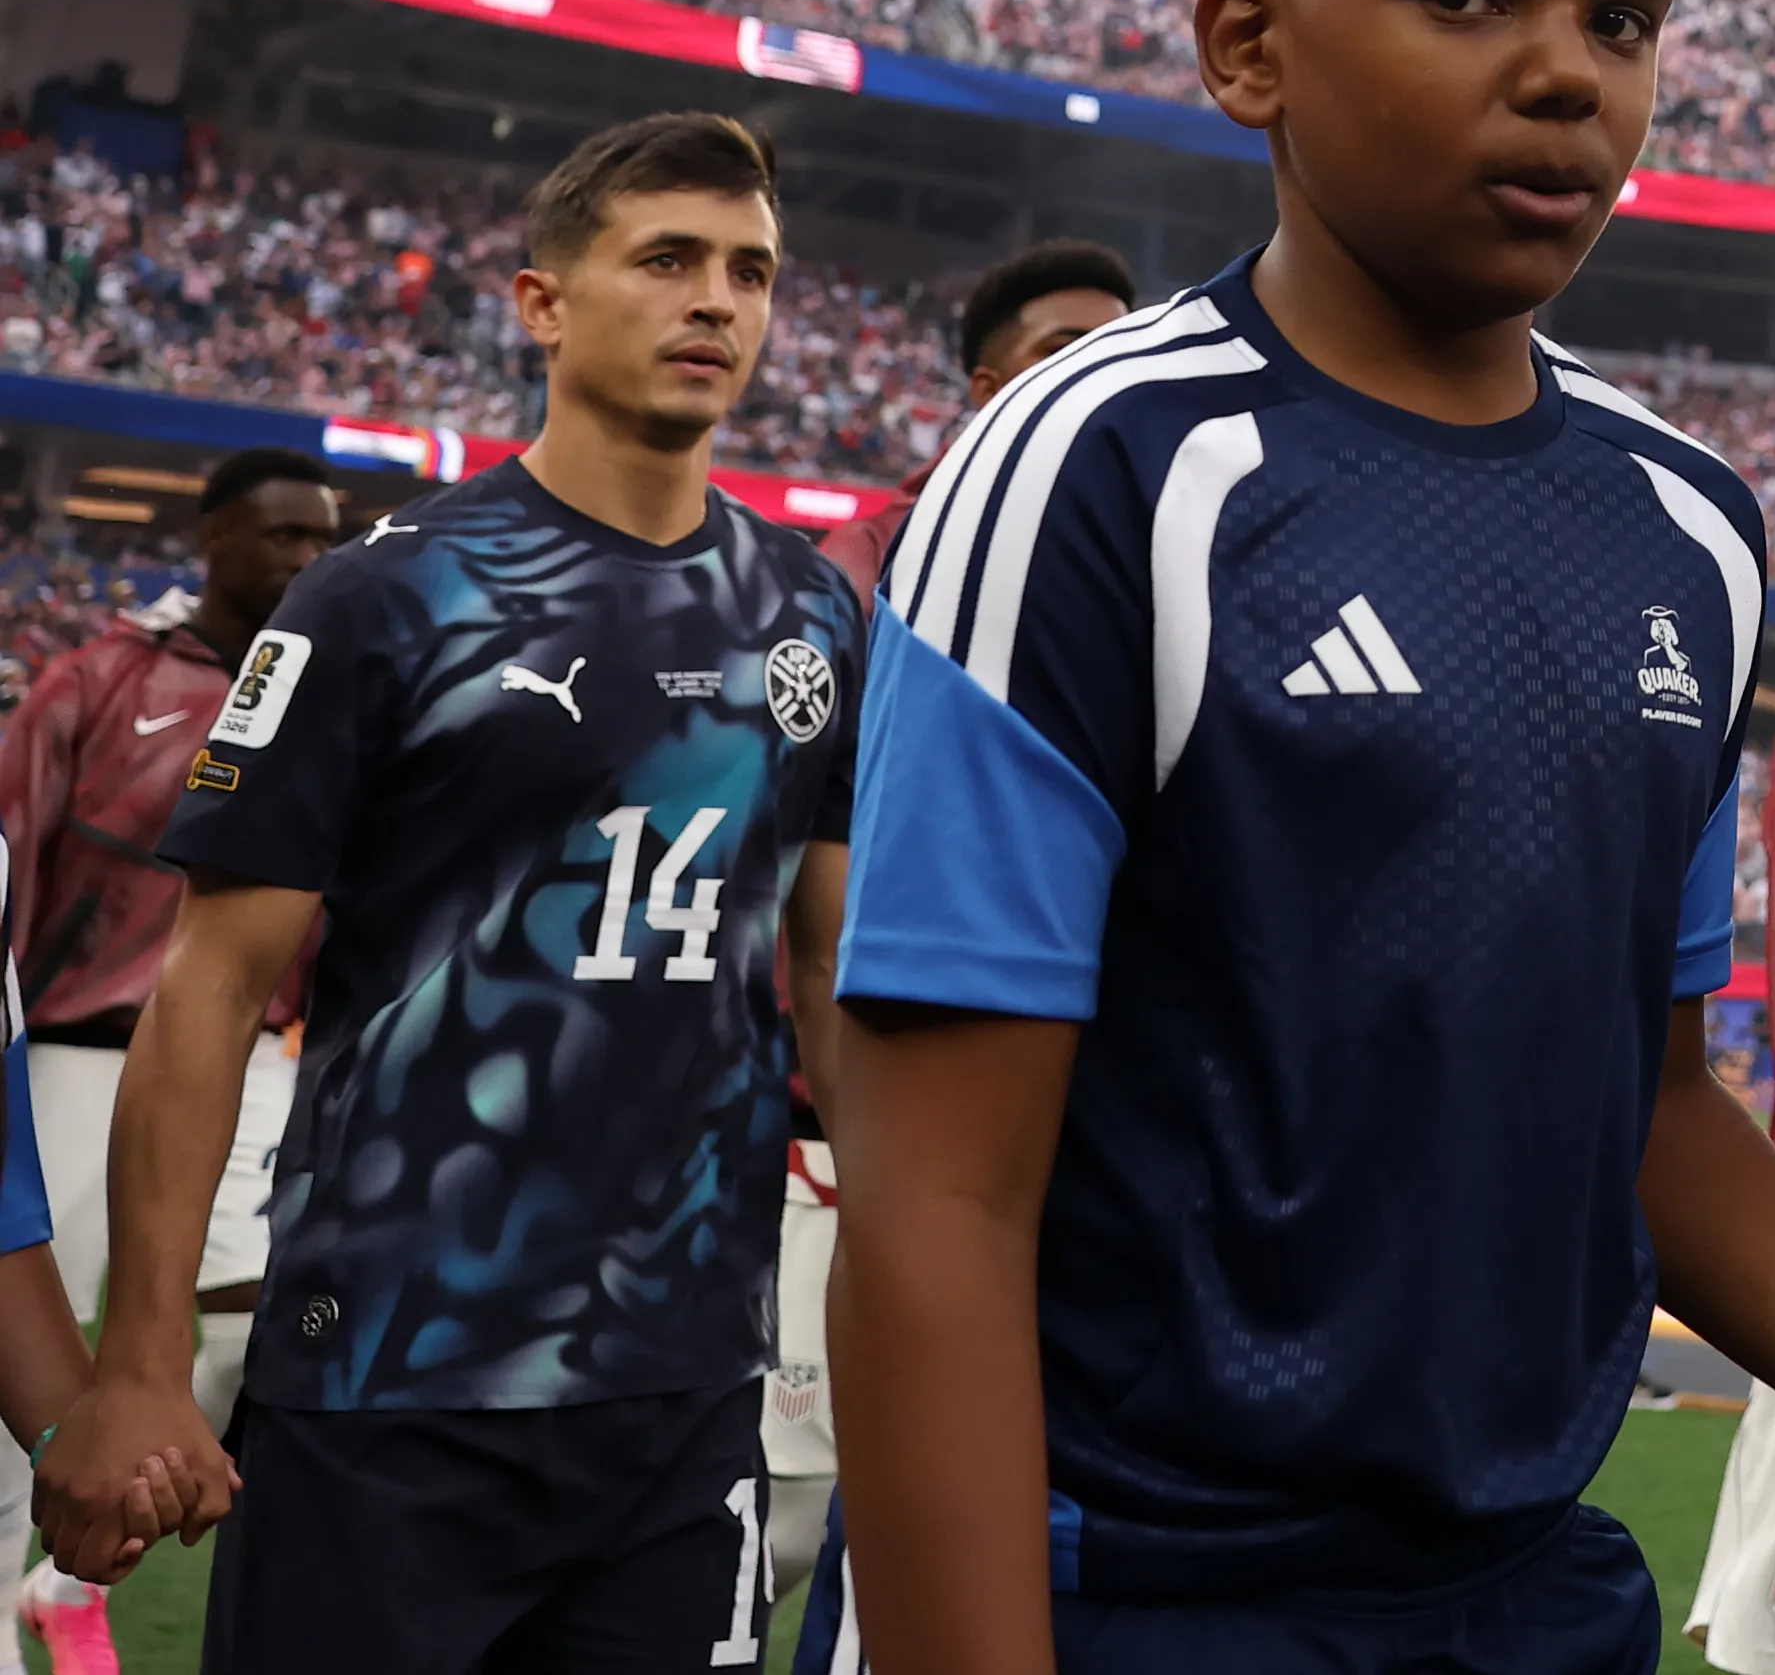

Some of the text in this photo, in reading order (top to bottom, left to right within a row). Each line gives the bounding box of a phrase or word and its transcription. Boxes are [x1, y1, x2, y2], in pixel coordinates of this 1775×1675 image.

[1637, 666, 1699, 703] QUAKER
[1642, 708, 1676, 722] PLAYER
[572, 805, 729, 982] 14
[709, 1477, 774, 1667] 1
